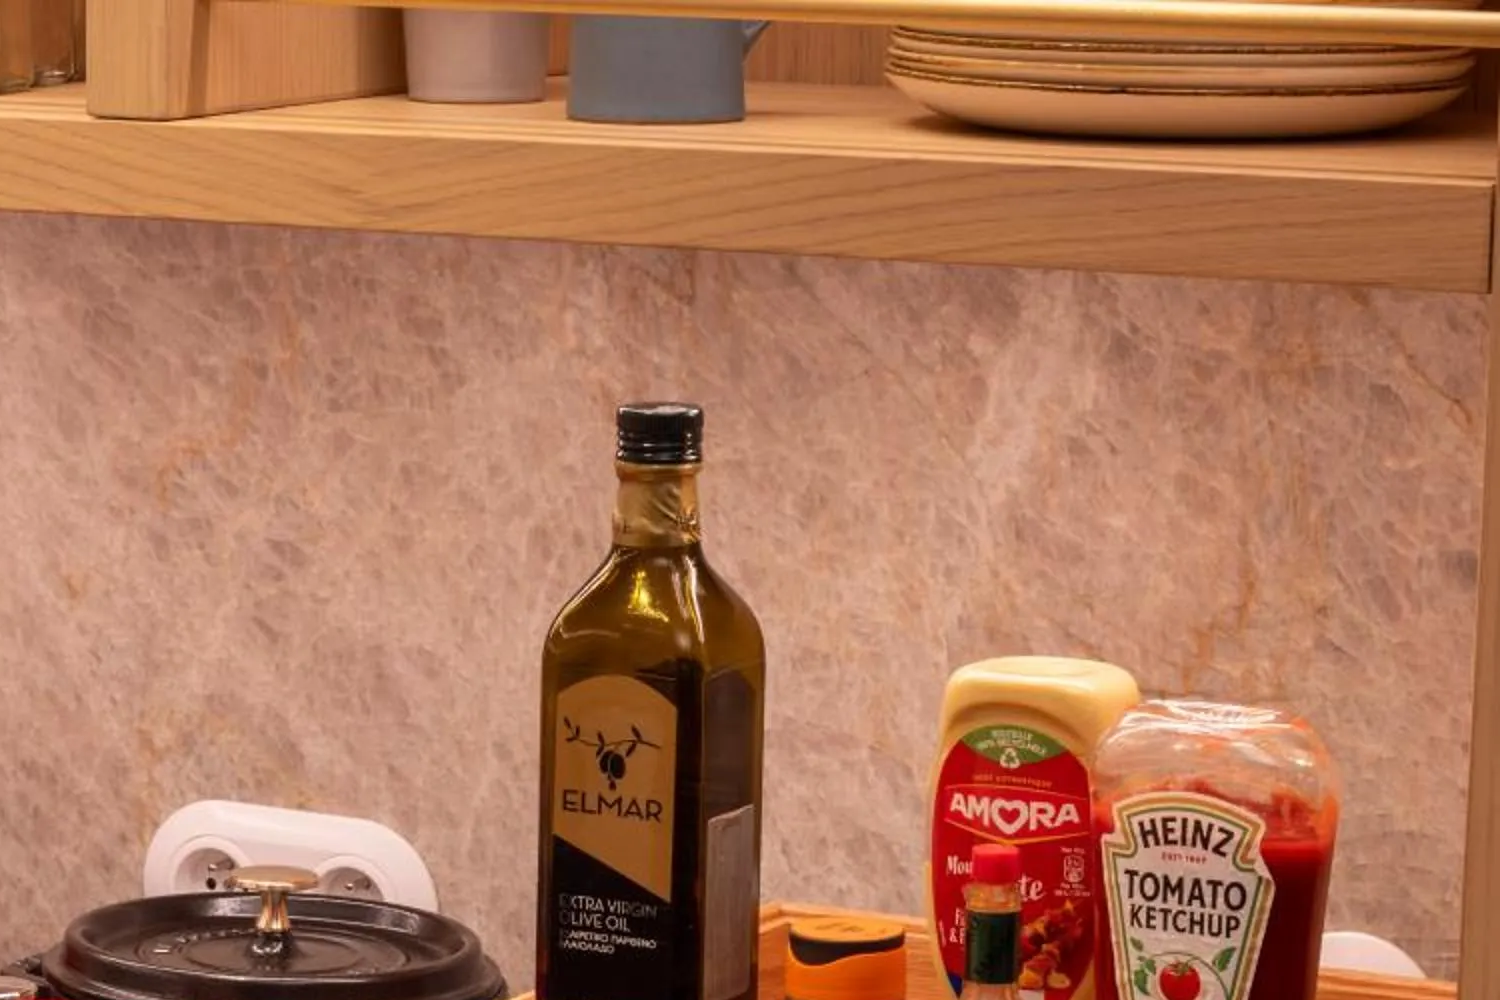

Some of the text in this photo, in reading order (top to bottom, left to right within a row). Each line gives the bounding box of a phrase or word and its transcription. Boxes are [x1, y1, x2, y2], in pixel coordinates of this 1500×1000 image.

[562, 789, 663, 823] ELMAR
[949, 792, 1080, 835] AMORA
[1138, 816, 1235, 857] HEINZ
[558, 892, 658, 920] EXTRA VIRGIN
[1124, 869, 1248, 912] TOMATO
[558, 908, 631, 933] OLIVE OIL
[1129, 903, 1242, 939] KETCHUP
